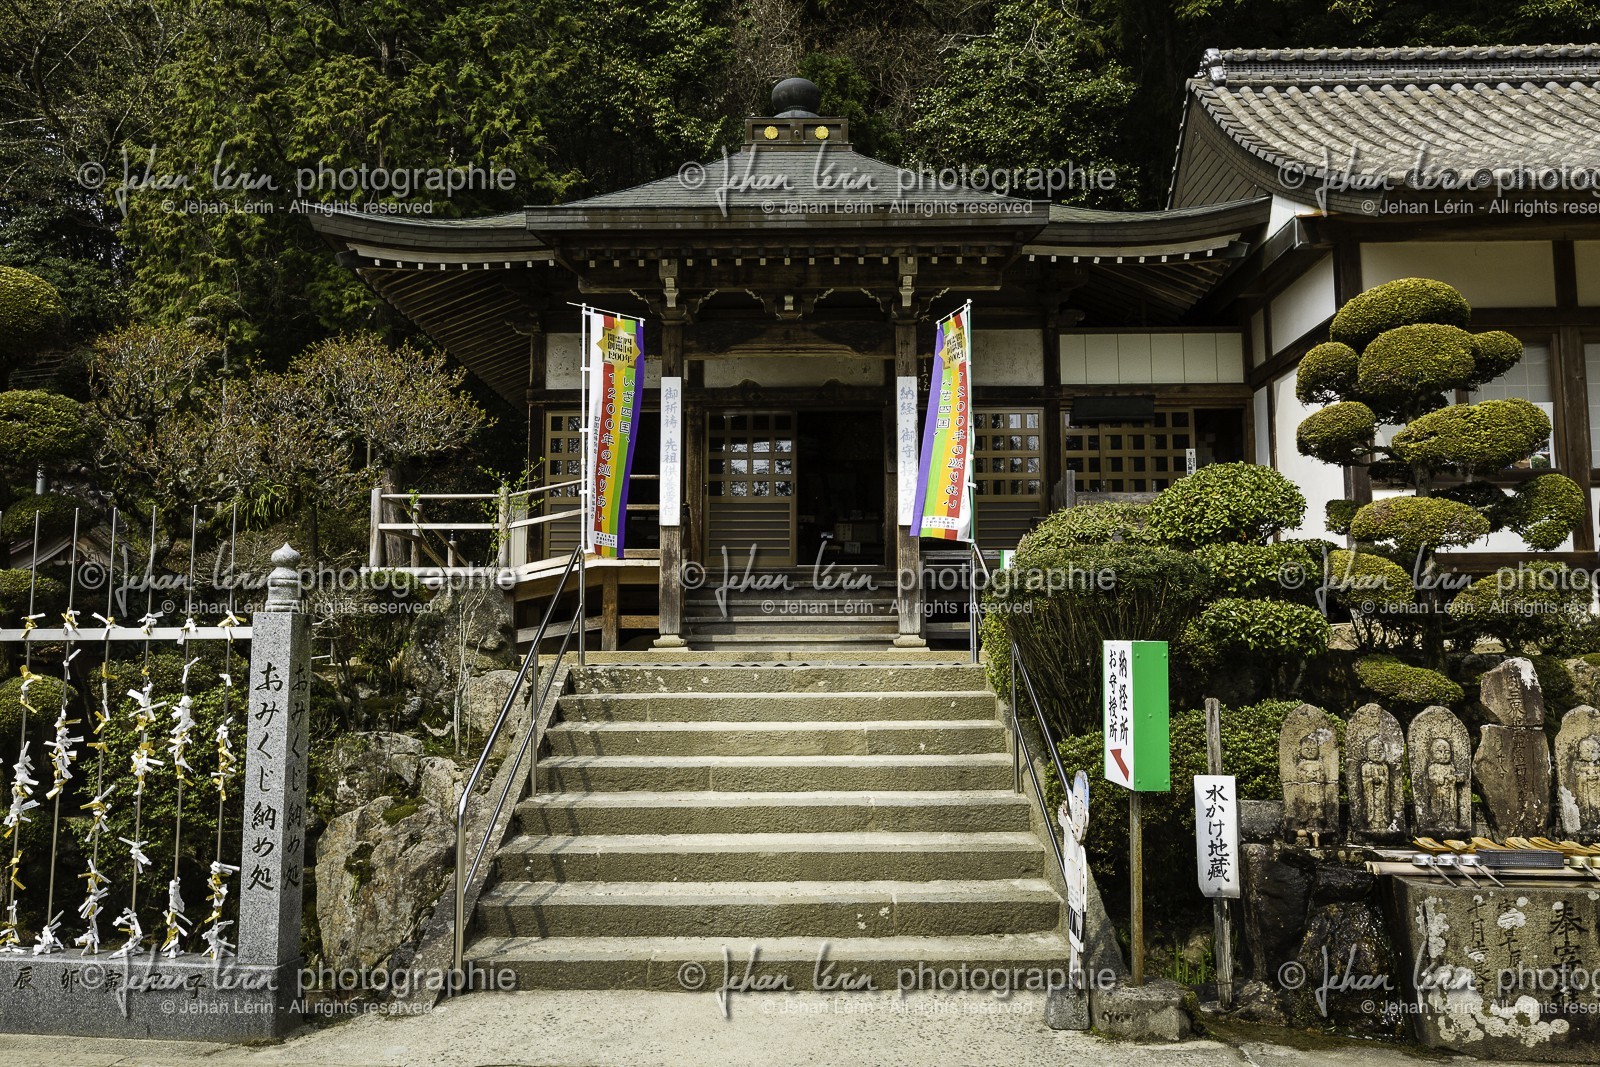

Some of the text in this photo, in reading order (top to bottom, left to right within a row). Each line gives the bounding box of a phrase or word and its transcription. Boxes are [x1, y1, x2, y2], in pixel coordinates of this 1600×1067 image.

[247, 660, 284, 892] おみくじ納め処
[1205, 783, 1230, 884] 水かけ地蔵
[12, 966, 36, 991] 辰
